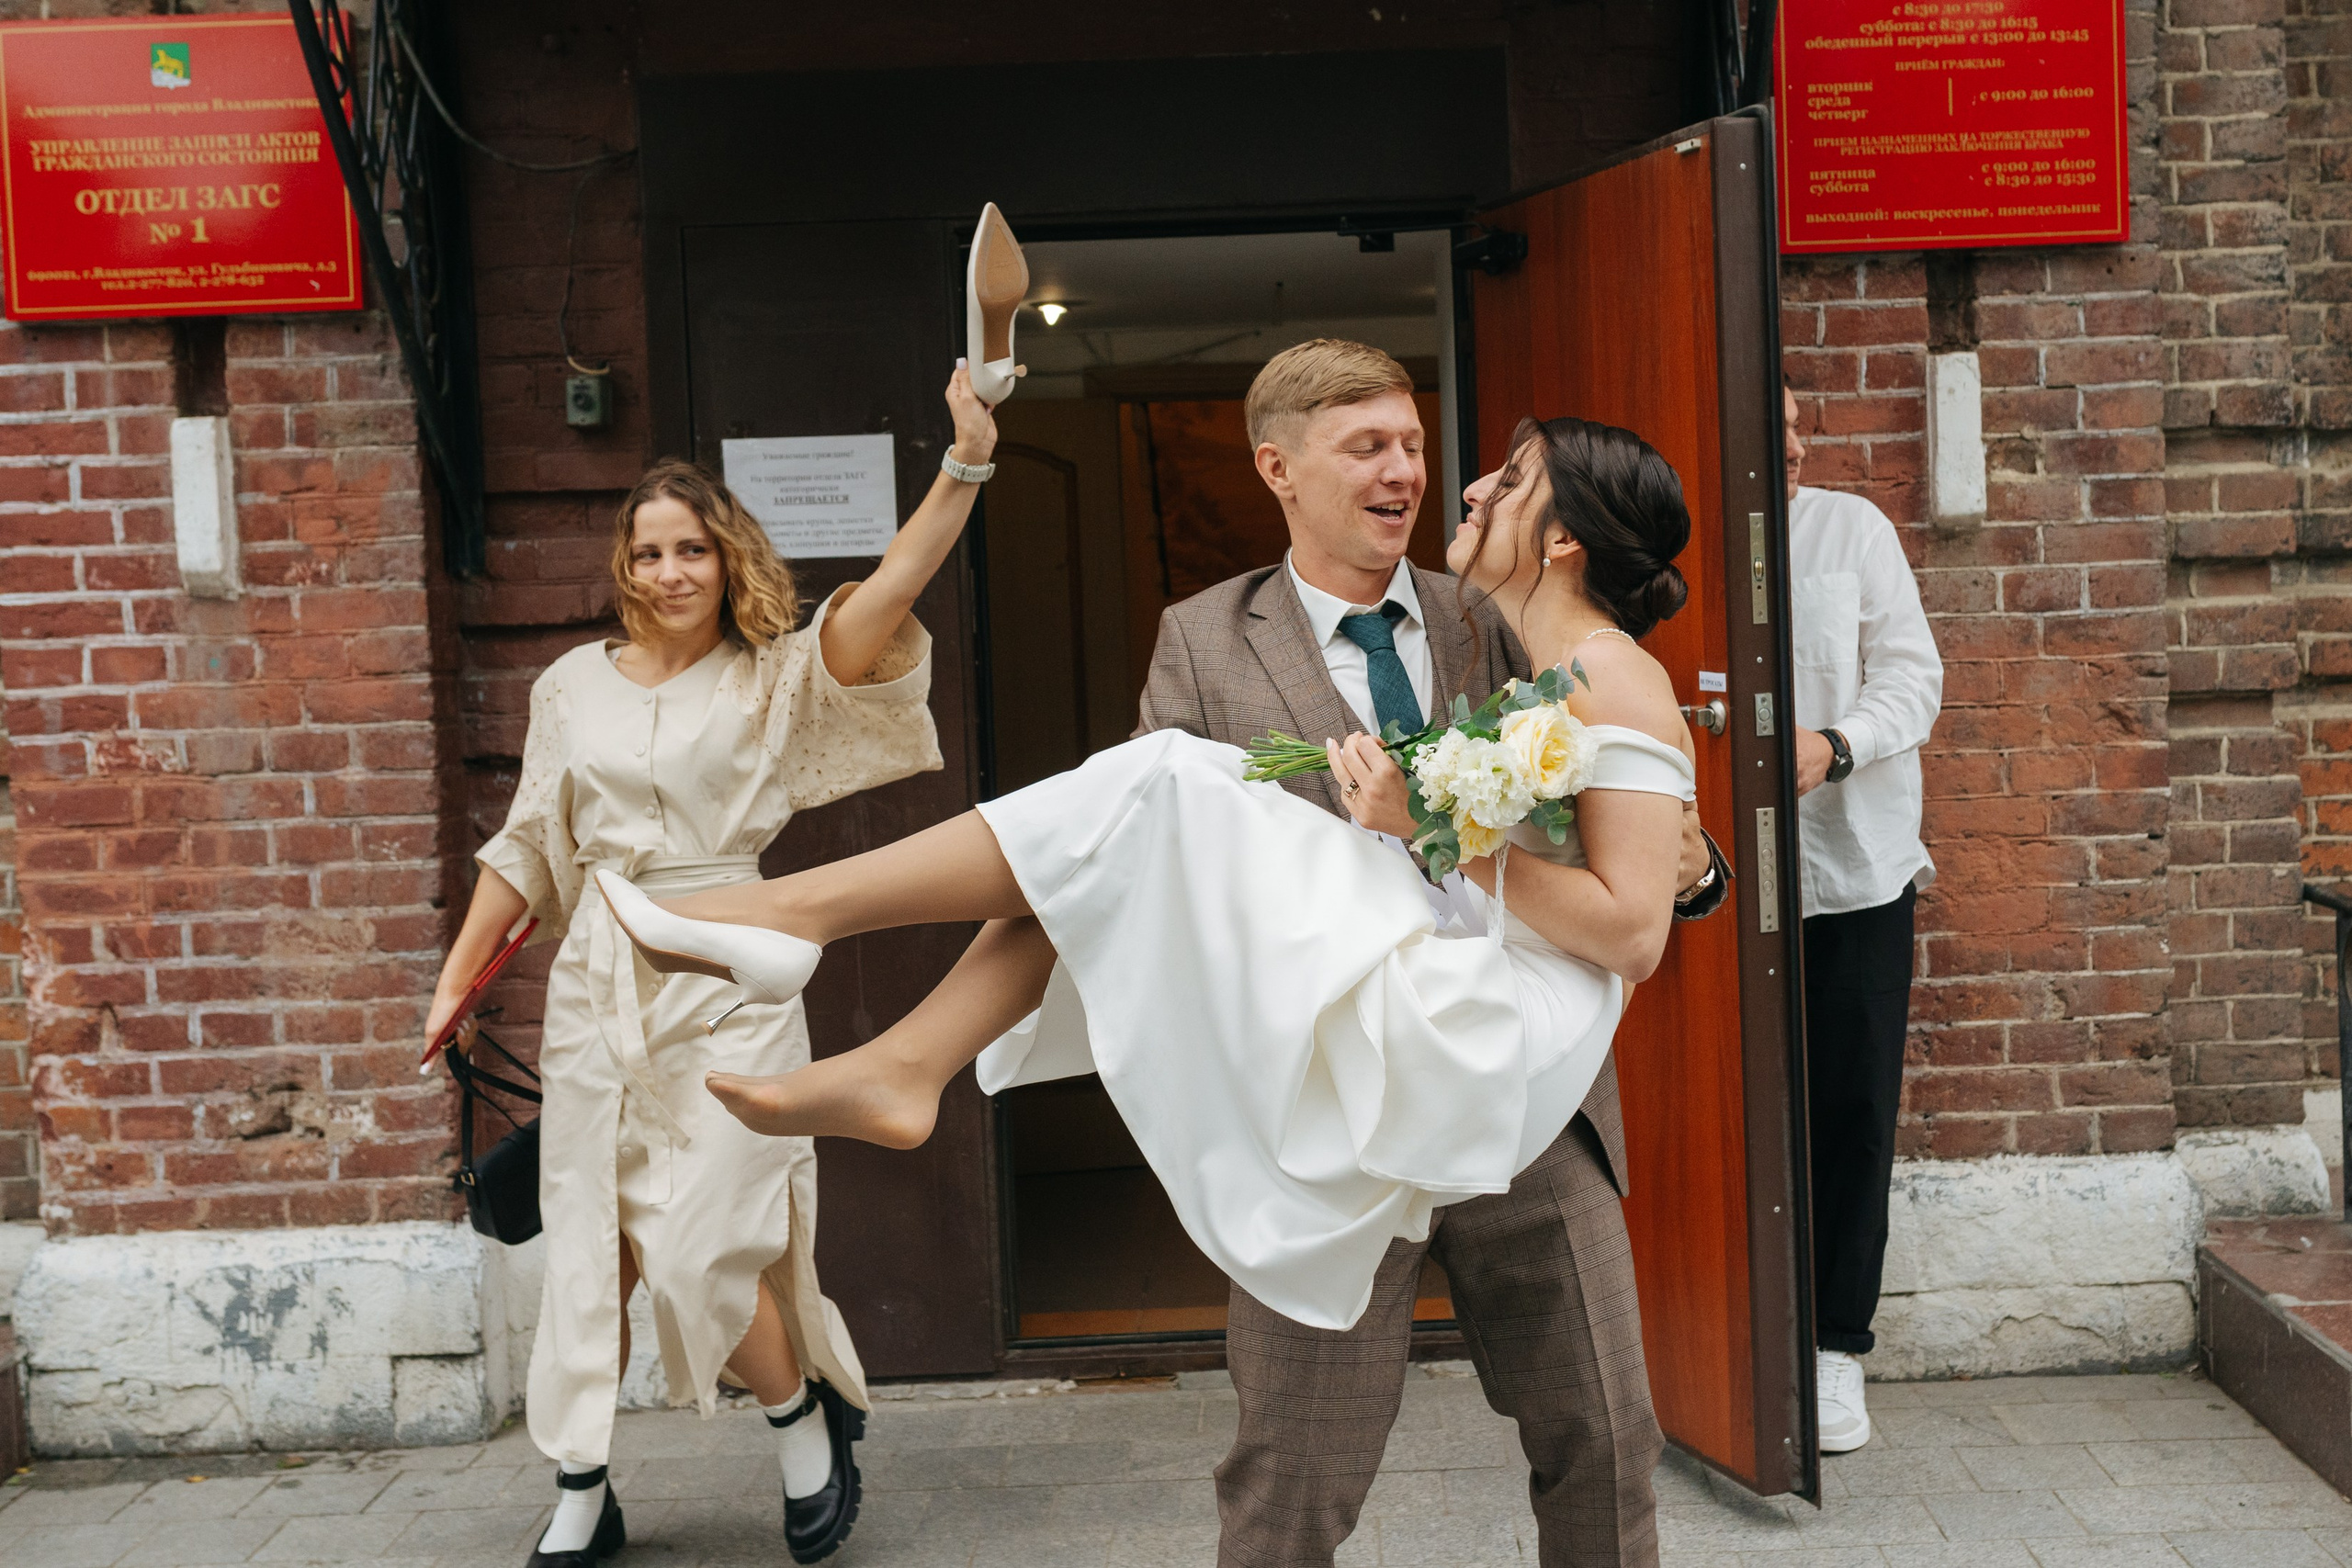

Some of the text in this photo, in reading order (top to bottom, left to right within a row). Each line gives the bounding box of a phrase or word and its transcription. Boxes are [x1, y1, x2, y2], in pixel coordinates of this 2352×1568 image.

[1904, 3, 1939, 17] 8:30
[1941, 4, 1962, 17] до
[1964, 1, 2004, 15] 17:30
[1860, 18, 1926, 35] суббота:
[1939, 17, 1974, 32] 8:30
[1976, 18, 1997, 31] до
[2000, 16, 2039, 30] 16:15
[1805, 32, 1894, 51] обеденный
[1897, 32, 1966, 49] перерыв
[1983, 30, 2024, 47] 13:00
[2027, 30, 2046, 42] до
[2050, 28, 2089, 43] 13:45
[1807, 81, 1873, 96] вторник
[1991, 89, 2026, 103] 9:00
[2030, 89, 2050, 101] до
[2052, 86, 2094, 99] 16:00
[24, 102, 151, 119] Администрация
[155, 100, 209, 116] города
[1807, 95, 1850, 110] среда
[1808, 108, 1869, 121] четверг
[30, 130, 321, 155] УПРАВЛЕНИЕ ЗАПИСИ АКТОВ
[32, 147, 320, 173] ГРАЖДАНСКОГО СОСТОЯНИЯ
[1993, 161, 2028, 175] 9:00
[2030, 161, 2050, 173] до
[2053, 158, 2096, 171] 16:00
[1810, 166, 1876, 181] пятница
[1996, 173, 2030, 188] 8:30
[2033, 174, 2052, 186] до
[2055, 171, 2096, 186] 15:30
[1810, 179, 1870, 196] суббота
[74, 184, 281, 216] ОТДЕЛ ЗАГС
[1805, 209, 1889, 225] выходной:
[1997, 203, 2100, 219] понедельник
[190, 217, 209, 243] 1
